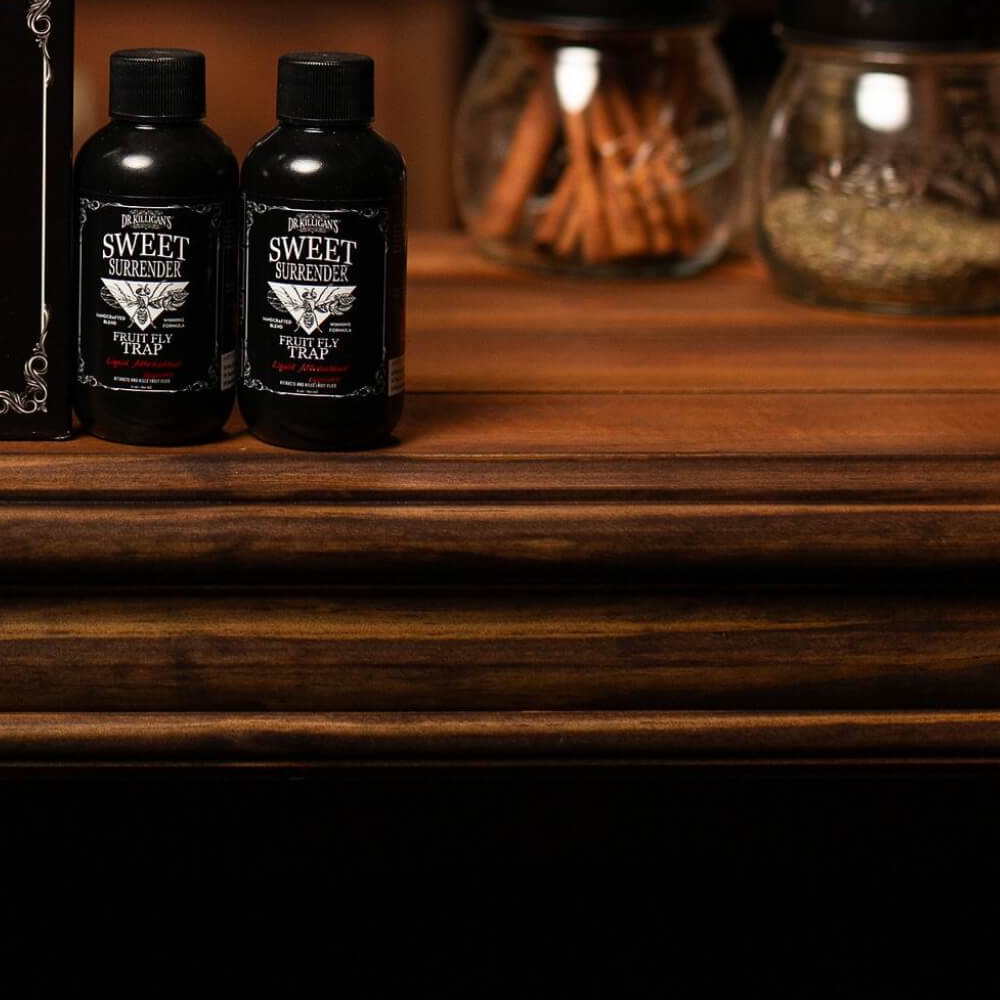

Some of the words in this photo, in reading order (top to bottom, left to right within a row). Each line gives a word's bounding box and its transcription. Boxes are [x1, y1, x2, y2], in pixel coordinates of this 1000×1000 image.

[102, 232, 190, 262] SWEET
[268, 235, 357, 265] SWEET
[108, 258, 182, 279] SURRENDER
[275, 261, 349, 282] SURRENDER
[113, 331, 148, 344] FRUIT
[151, 333, 173, 344] FLY
[279, 334, 315, 348] FRUIT
[317, 337, 340, 348] FLY
[121, 341, 163, 356] TRAP
[287, 345, 329, 360] TRAP
